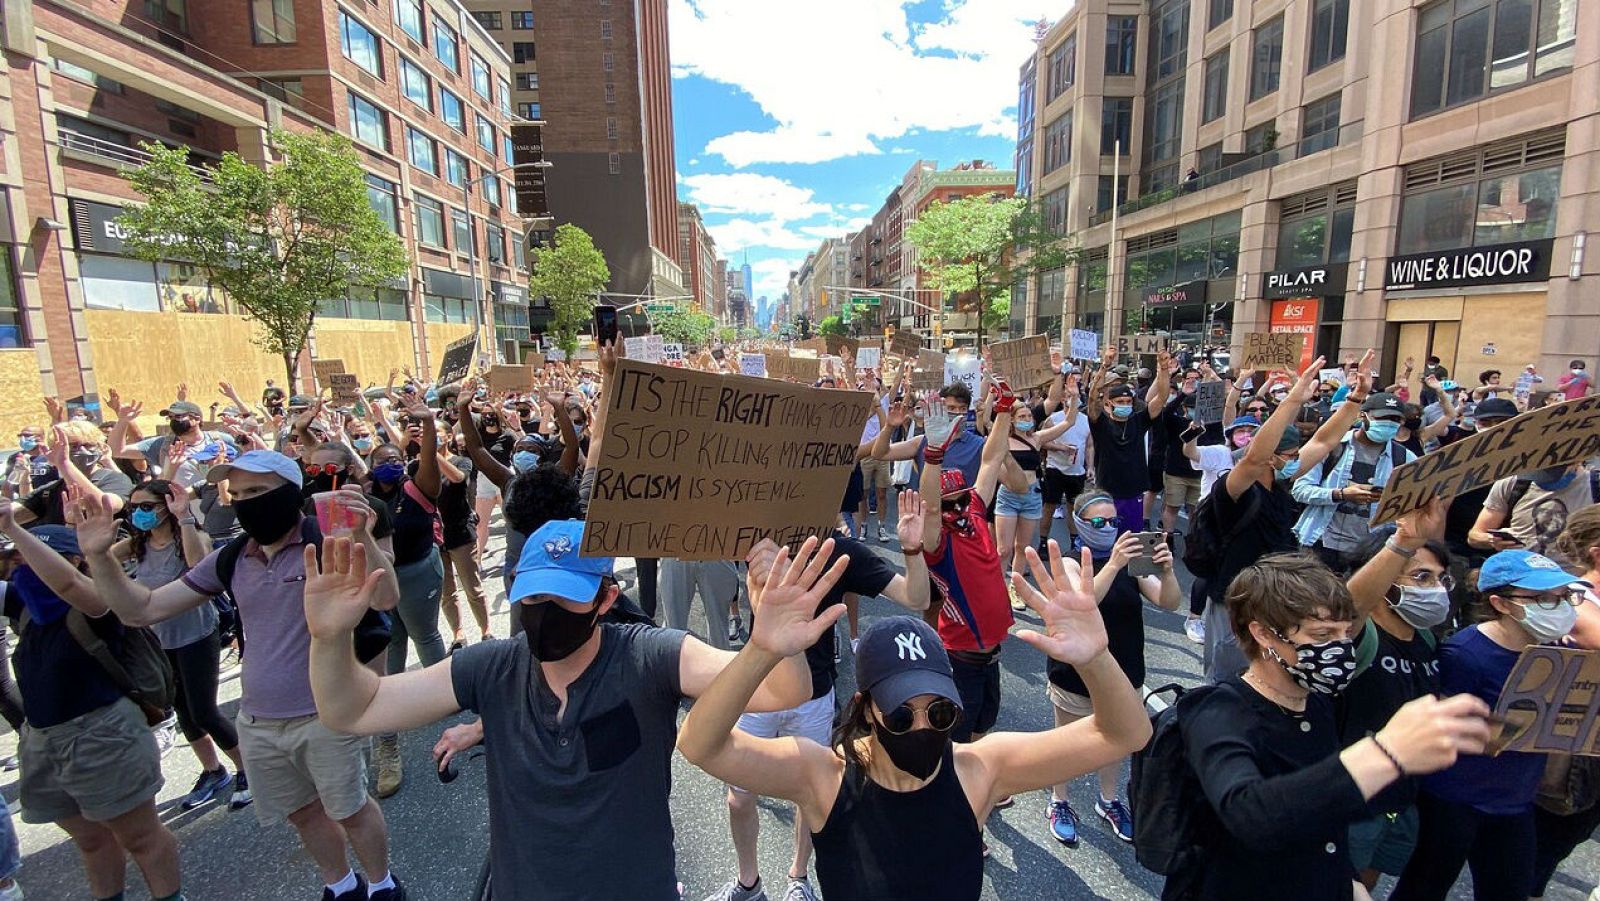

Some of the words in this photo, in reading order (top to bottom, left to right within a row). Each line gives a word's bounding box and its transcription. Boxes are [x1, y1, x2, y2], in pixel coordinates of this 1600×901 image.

[1268, 270, 1325, 288] PILAR
[1391, 258, 1434, 283] WINE
[1436, 257, 1449, 280] &
[1453, 249, 1532, 279] LIQUOR
[1172, 291, 1187, 302] SPA
[1250, 332, 1295, 346] BLACK
[1293, 324, 1314, 333] SPACE
[1245, 354, 1294, 366] MATTER
[1258, 344, 1292, 354] LIVES
[616, 369, 665, 412] IT'S
[669, 380, 713, 418] THE
[715, 387, 780, 427] RIGHT
[779, 395, 828, 434] THING
[829, 401, 848, 428] TO
[849, 404, 867, 428] DO
[1541, 415, 1600, 436] THE
[607, 422, 690, 461] STOP
[698, 431, 773, 470] KILLING
[778, 440, 803, 469] MY
[801, 441, 858, 469] FRIENDS
[1392, 415, 1534, 493] POLICE
[592, 468, 681, 500] RACISM
[689, 477, 705, 499] IS
[1376, 473, 1461, 521] BLUE
[1456, 448, 1539, 492] KLUX
[587, 521, 647, 552] BUT
[647, 523, 680, 552] WE
[681, 523, 729, 555] CAN
[894, 632, 927, 660] NY
